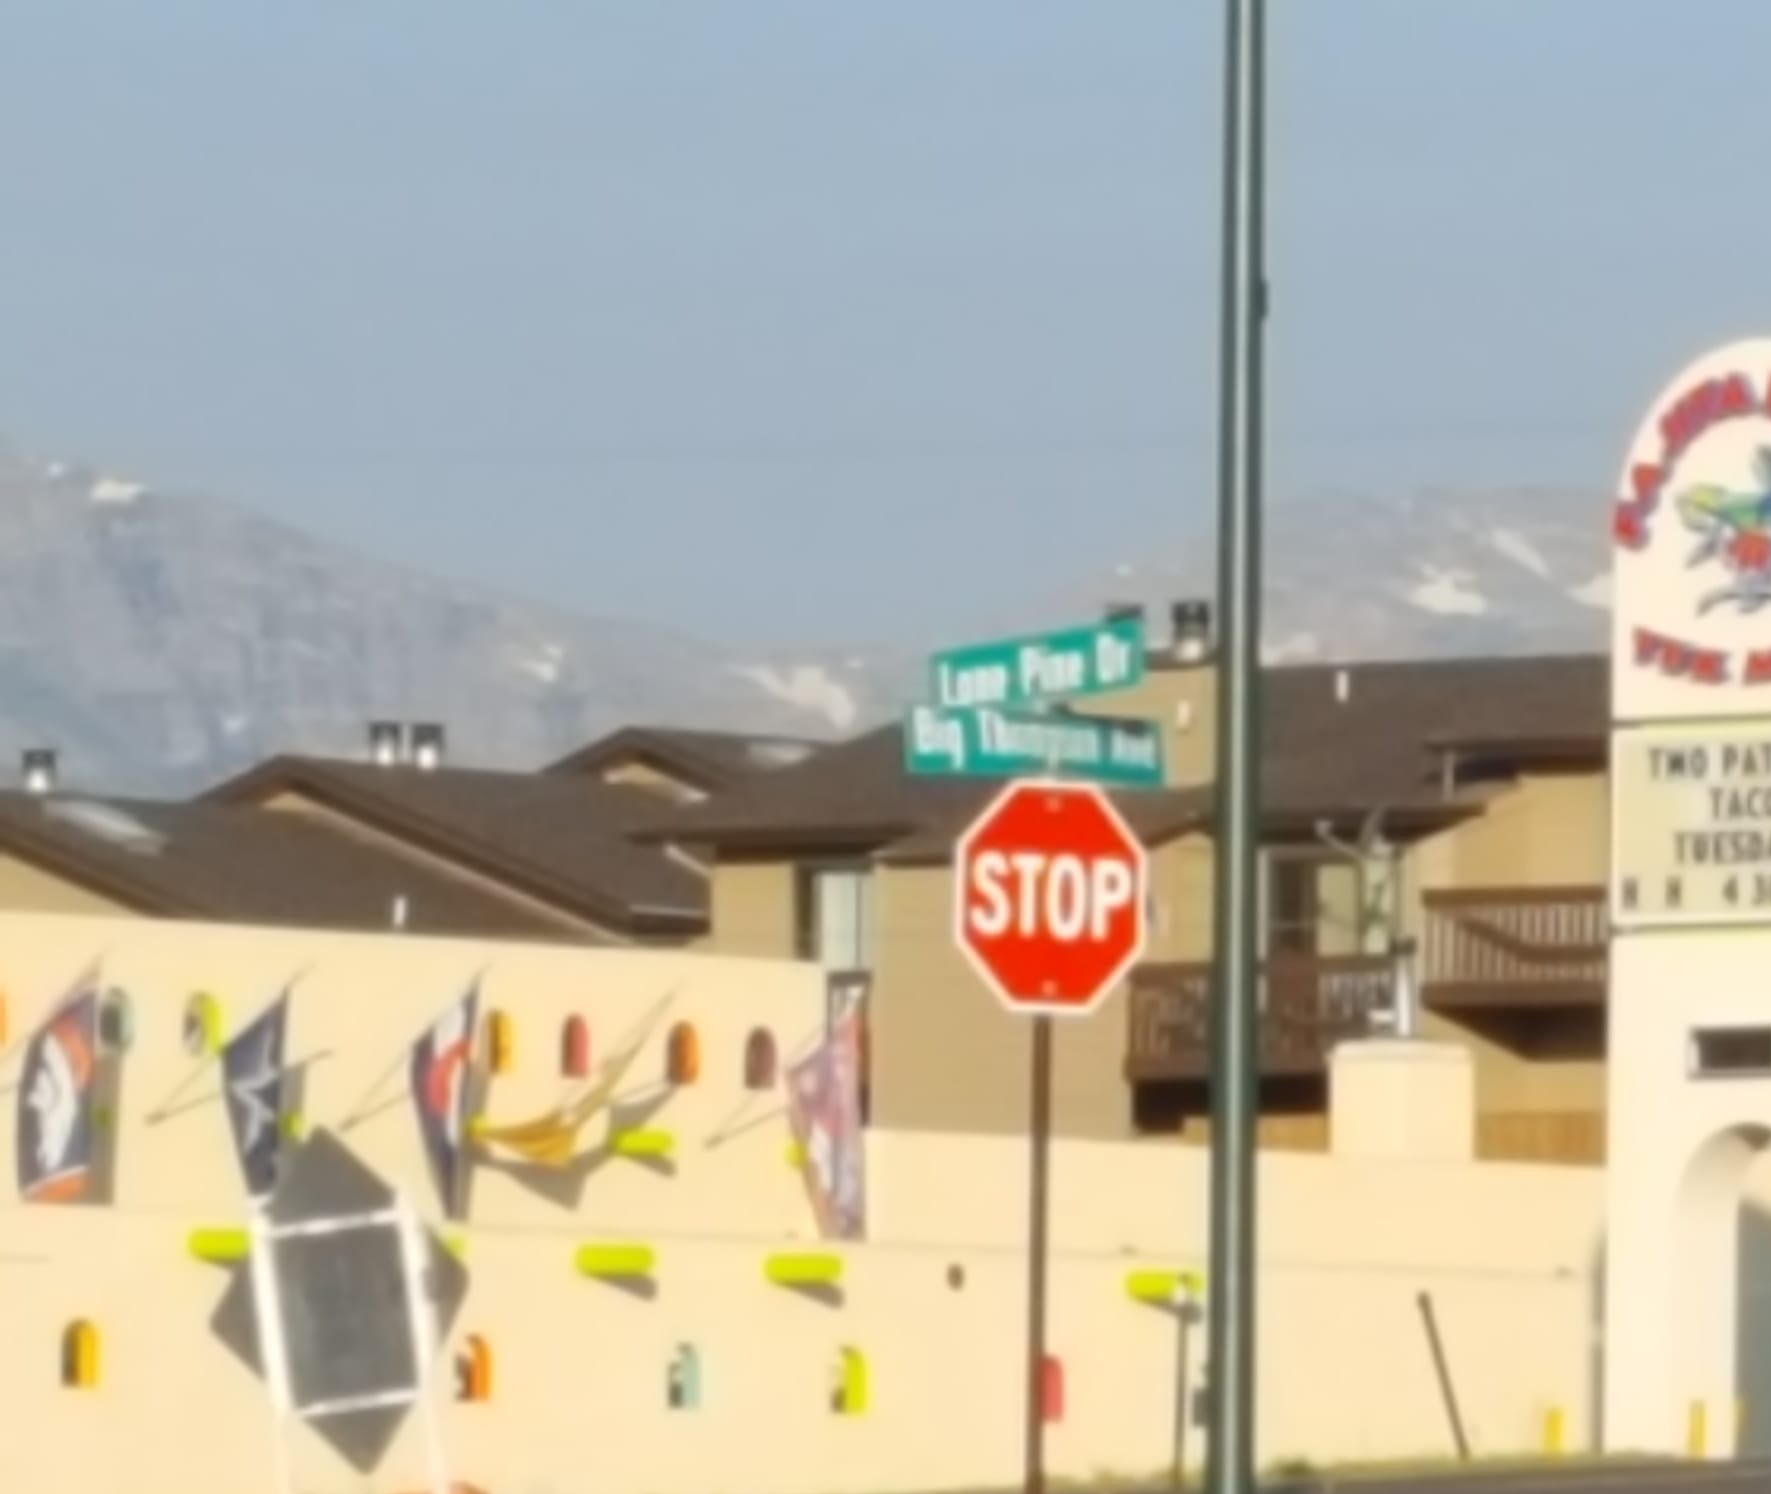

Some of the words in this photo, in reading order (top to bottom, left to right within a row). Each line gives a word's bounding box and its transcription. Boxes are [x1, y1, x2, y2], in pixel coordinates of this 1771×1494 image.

[939, 660, 1007, 706] Lone
[1019, 646, 1084, 697] Pine
[1096, 632, 1130, 685] Dr
[913, 705, 966, 771] Big
[1648, 745, 1708, 780] TWO
[970, 851, 1131, 942] STOP
